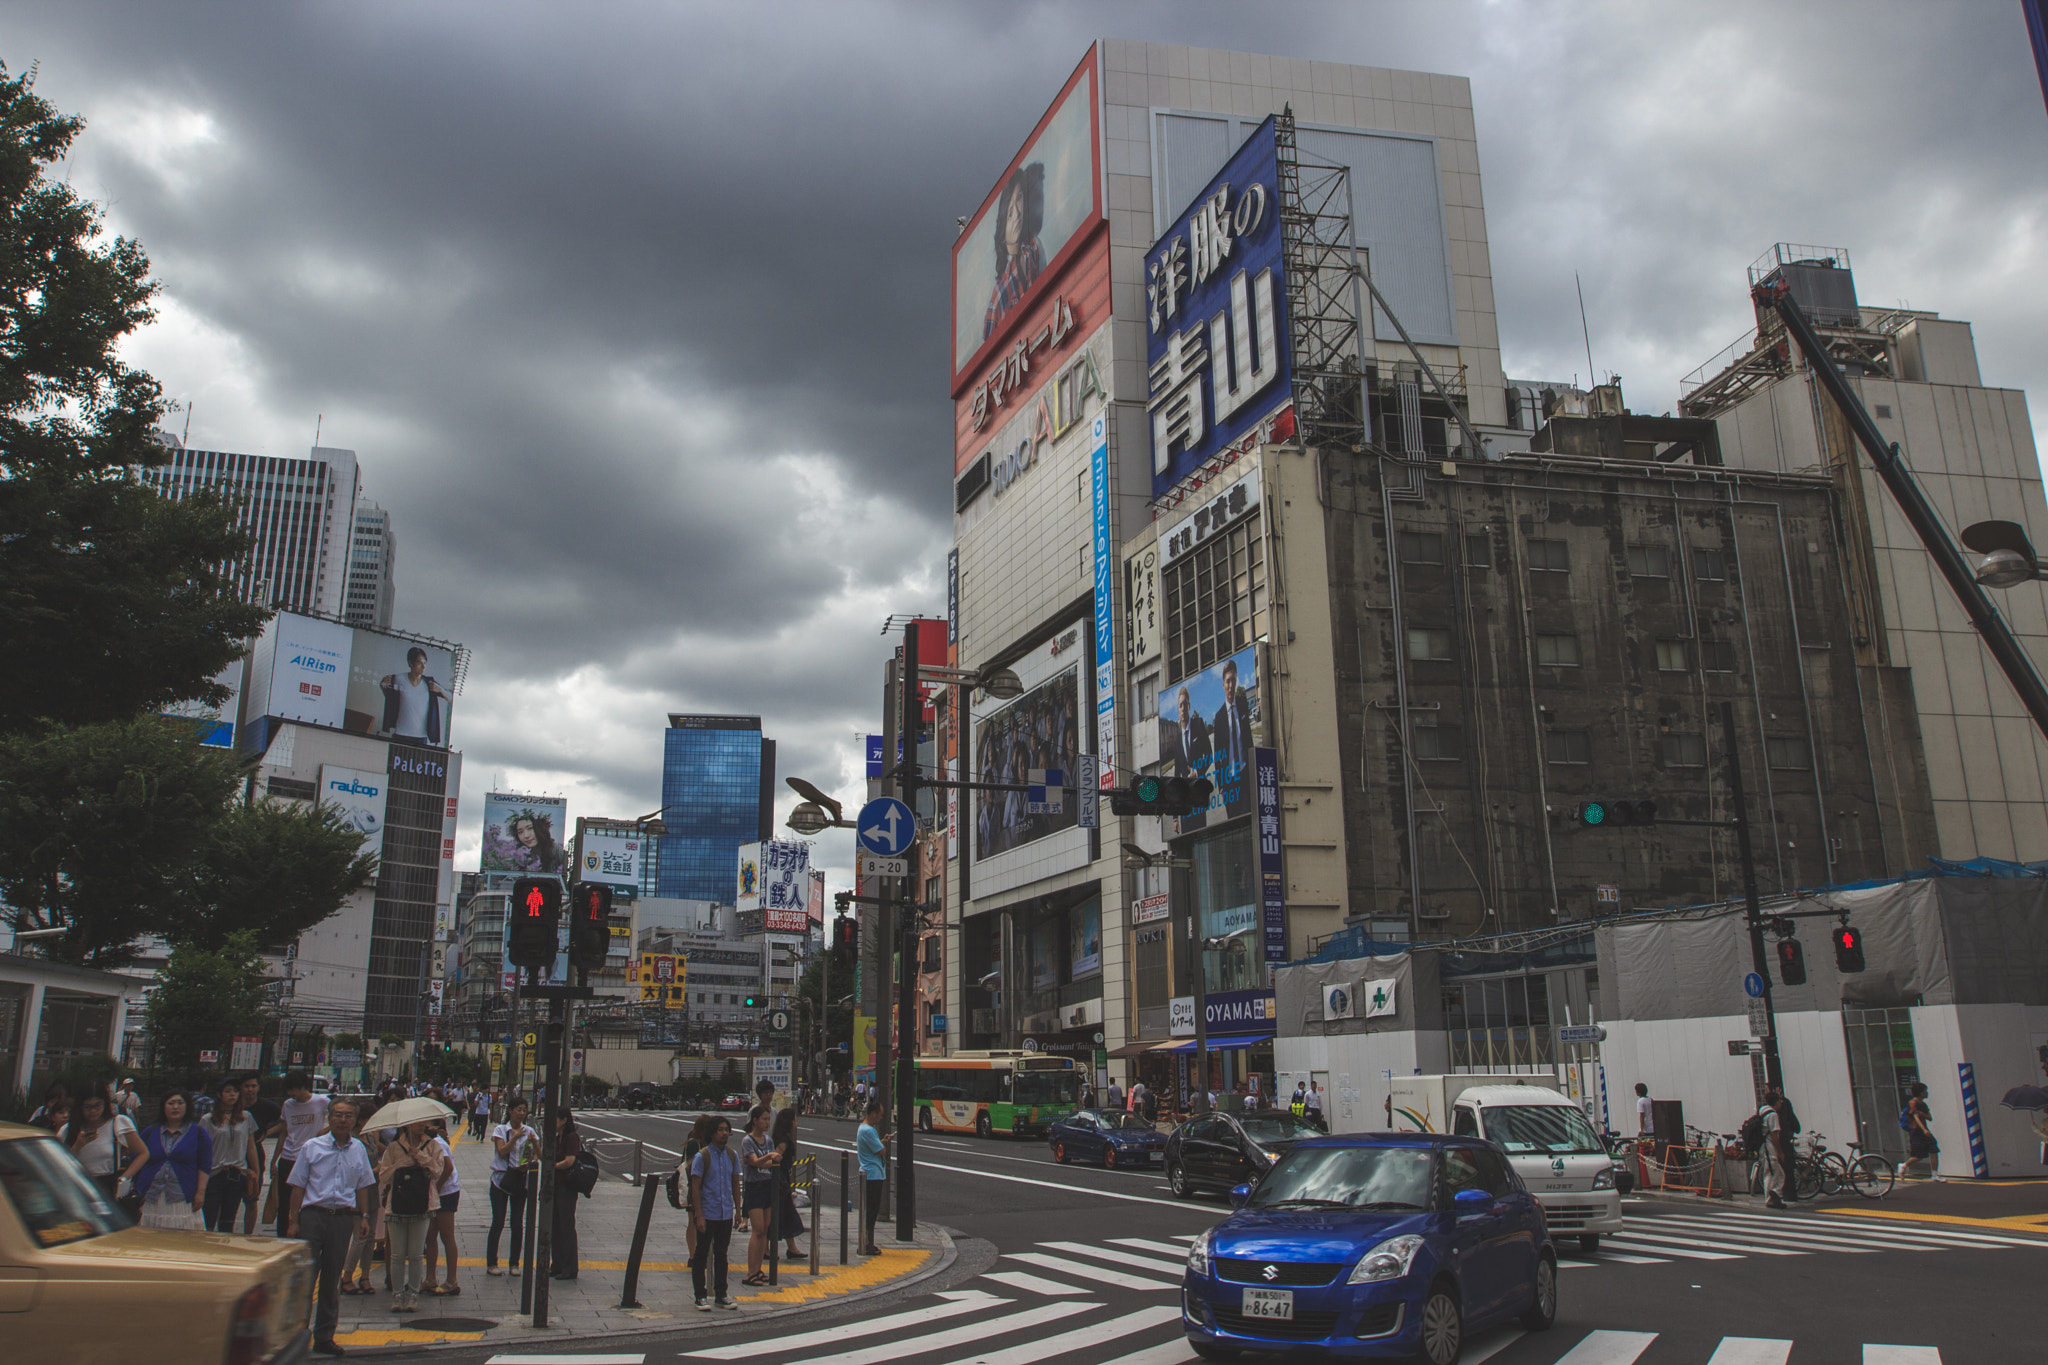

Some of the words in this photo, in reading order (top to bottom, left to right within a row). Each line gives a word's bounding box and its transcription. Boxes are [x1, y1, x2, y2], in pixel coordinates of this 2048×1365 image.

[1148, 182, 1266, 334] 洋服の
[971, 294, 1074, 433] タマホーム
[1148, 266, 1278, 477] 青山
[1096, 455, 1108, 653] コンタクトのアイシティ
[1134, 560, 1147, 657] ルノアール
[289, 655, 336, 673] AIRism
[1098, 672, 1111, 692] No.1
[1192, 748, 1227, 770] AOYAMA
[330, 779, 378, 797] raycop
[1081, 757, 1095, 826] スクランブル式
[1030, 803, 1061, 814] 時差式
[1259, 767, 1278, 854] 洋服の青山
[603, 851, 632, 861] シェーン
[769, 841, 809, 873] カラオケ
[602, 860, 632, 873] 英会話
[783, 869, 793, 886] の
[770, 882, 804, 910] 鉄人
[1224, 911, 1257, 928] AOYAMA
[1136, 928, 1165, 945] AOKI
[658, 961, 672, 979] 質
[1206, 1001, 1252, 1022] OYAMA
[1171, 1016, 1194, 1028] ルノアール
[527, 1035, 533, 1043] 1
[1041, 1043, 1075, 1051] Croissant
[1253, 1301, 1290, 1318] 86-47
